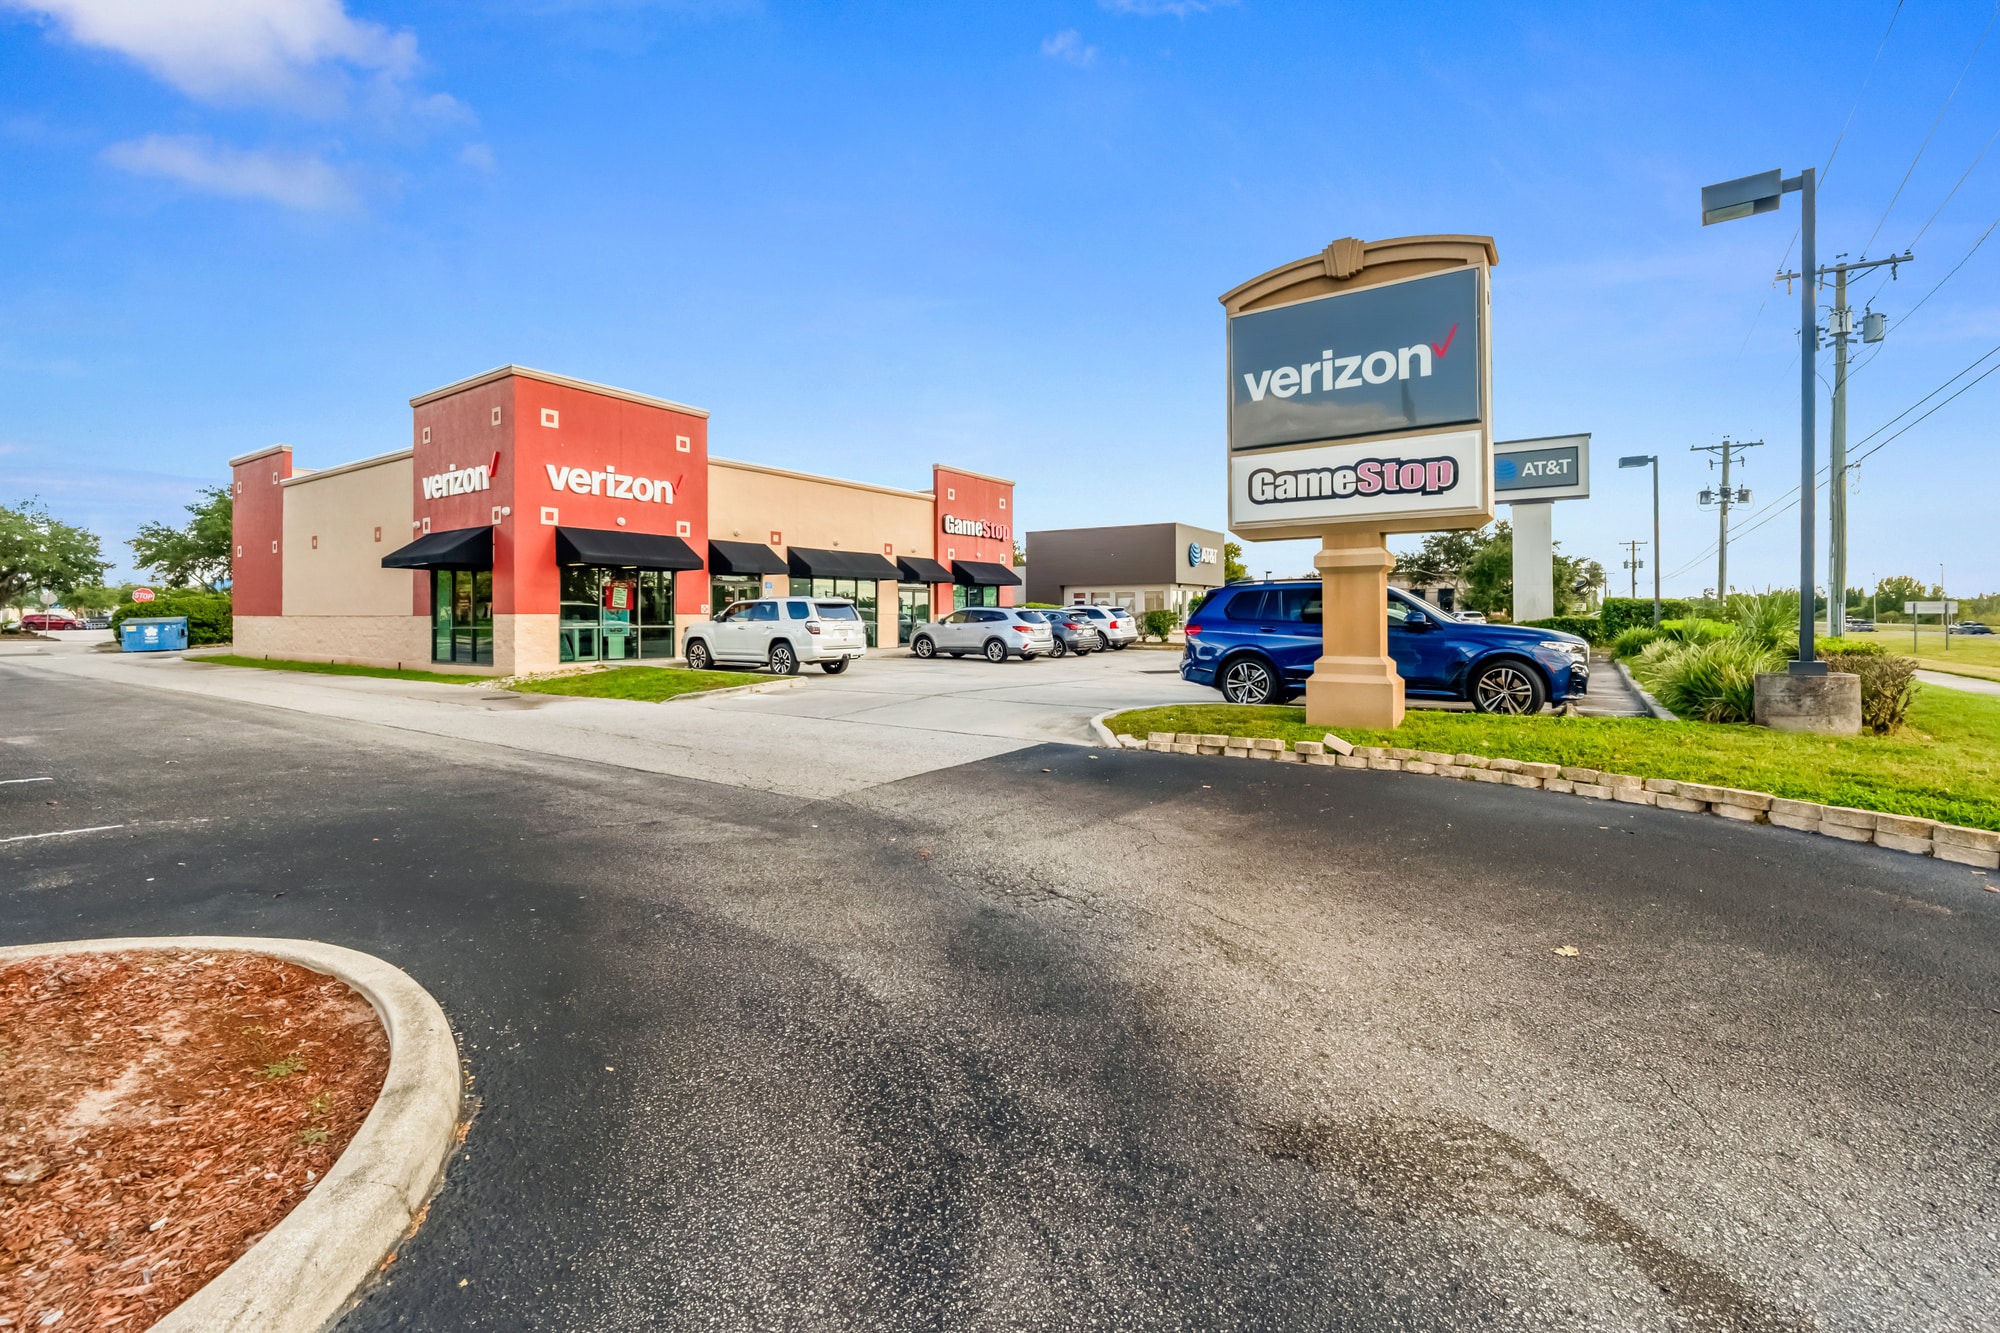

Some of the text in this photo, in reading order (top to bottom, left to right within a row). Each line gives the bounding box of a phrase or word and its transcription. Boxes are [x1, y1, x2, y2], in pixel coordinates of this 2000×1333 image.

[1243, 343, 1432, 402] verizon
[422, 463, 489, 500] verizon
[546, 464, 673, 504] verizon
[1248, 456, 1459, 504] GameStop
[1521, 458, 1572, 478] AT&T
[942, 514, 1010, 542] GameStop
[1201, 547, 1218, 564] AT&T
[134, 592, 154, 600] STOP
